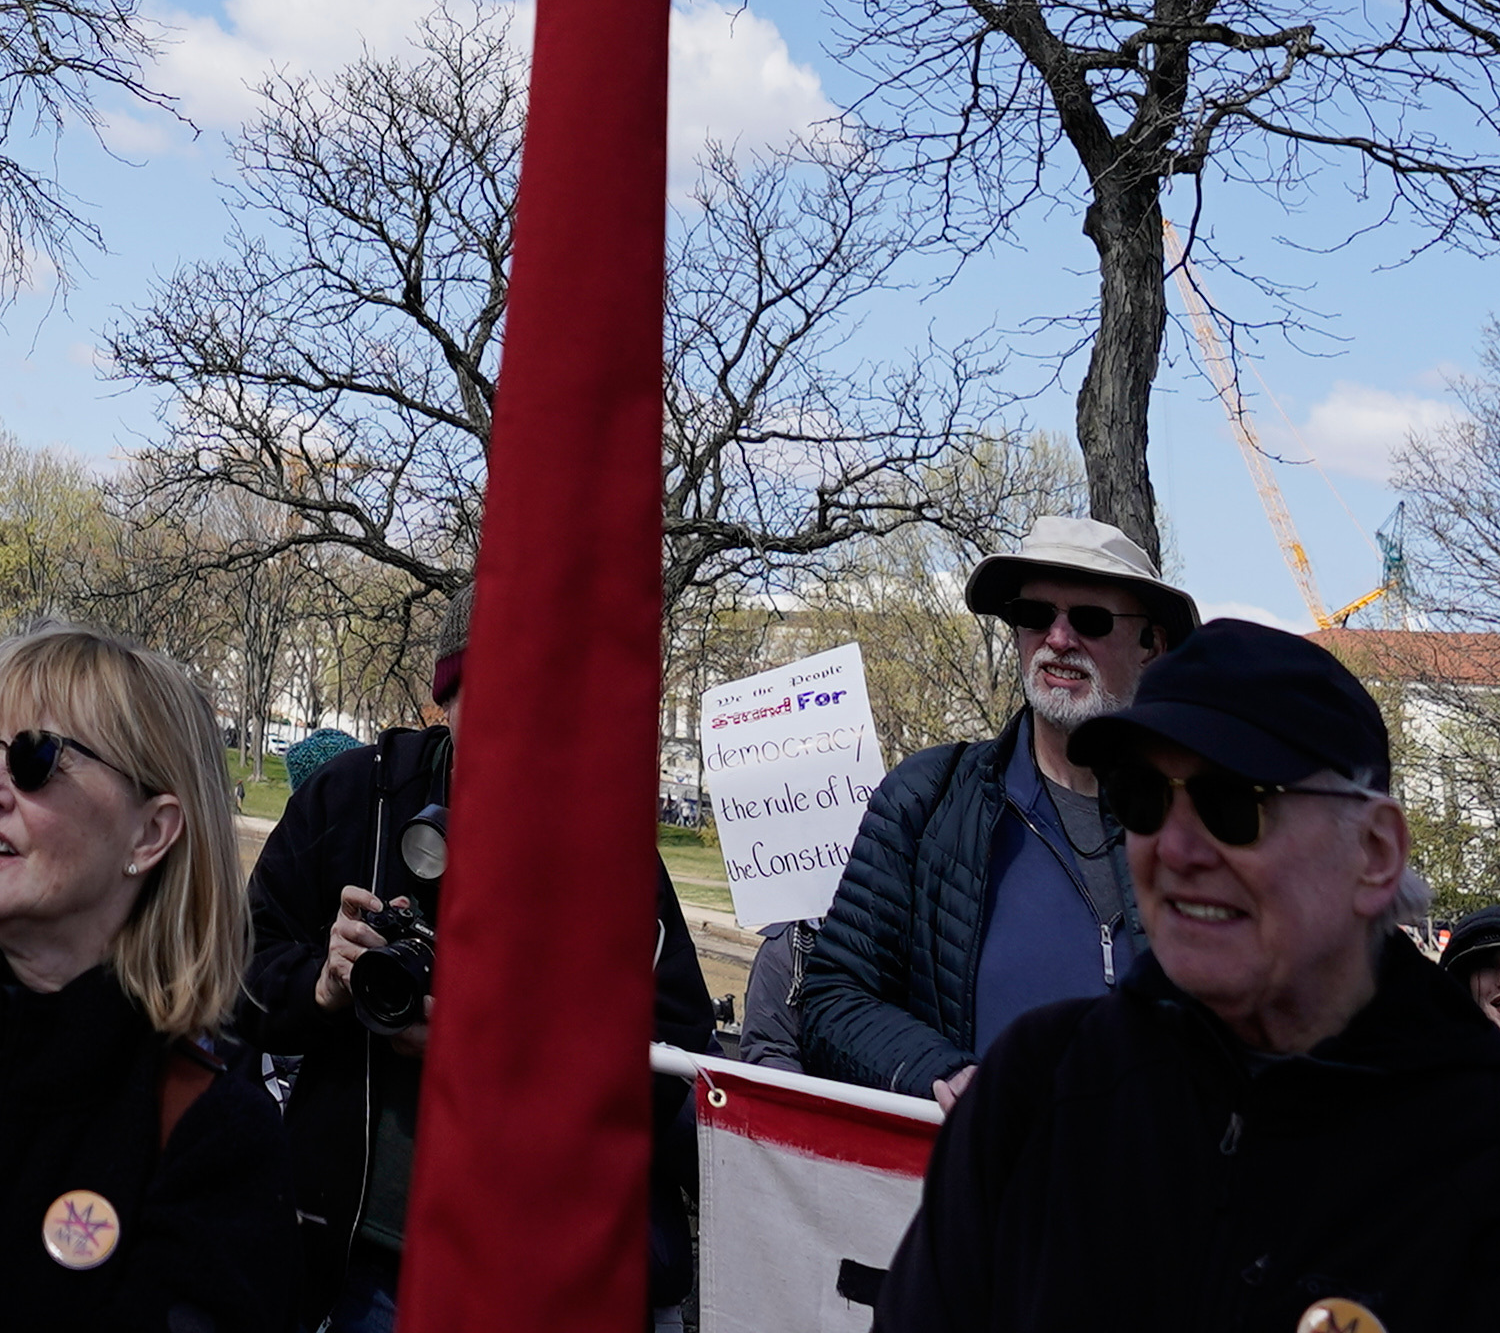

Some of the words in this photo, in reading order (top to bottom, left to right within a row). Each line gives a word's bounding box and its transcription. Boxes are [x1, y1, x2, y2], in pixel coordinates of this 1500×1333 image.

[788, 663, 844, 689] People
[797, 689, 848, 712] For
[706, 723, 866, 773] democracy
[720, 796, 760, 822] the
[764, 782, 811, 818] rule
[816, 774, 841, 810] of
[726, 858, 757, 883] the
